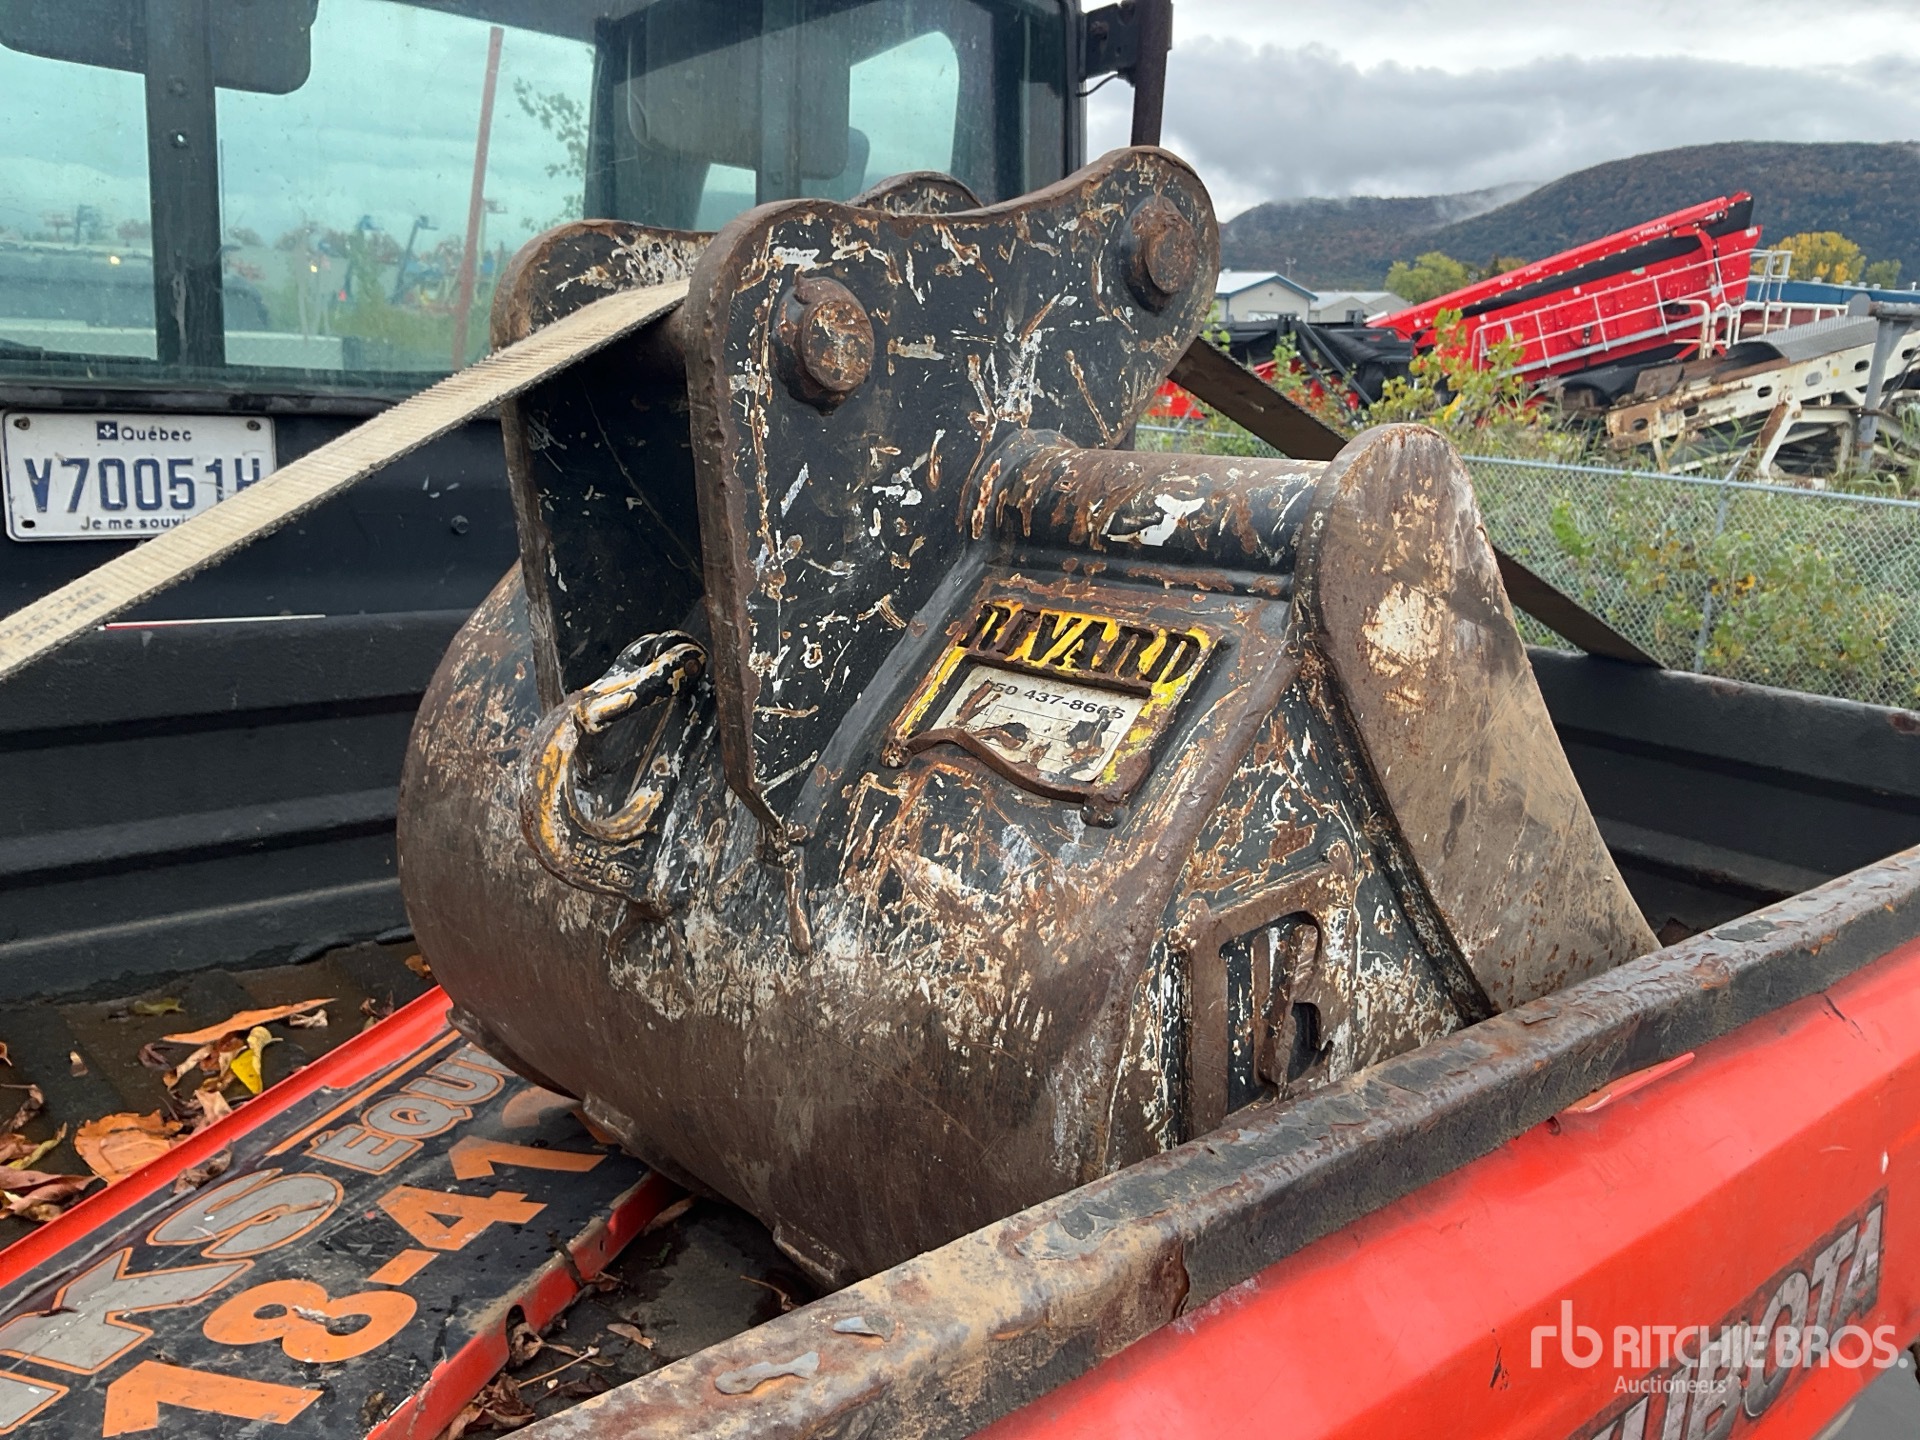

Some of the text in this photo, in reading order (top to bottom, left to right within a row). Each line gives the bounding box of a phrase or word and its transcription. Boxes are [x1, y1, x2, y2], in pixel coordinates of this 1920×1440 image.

[121, 426, 192, 442] Québec
[80, 514, 190, 530] Je me souvi
